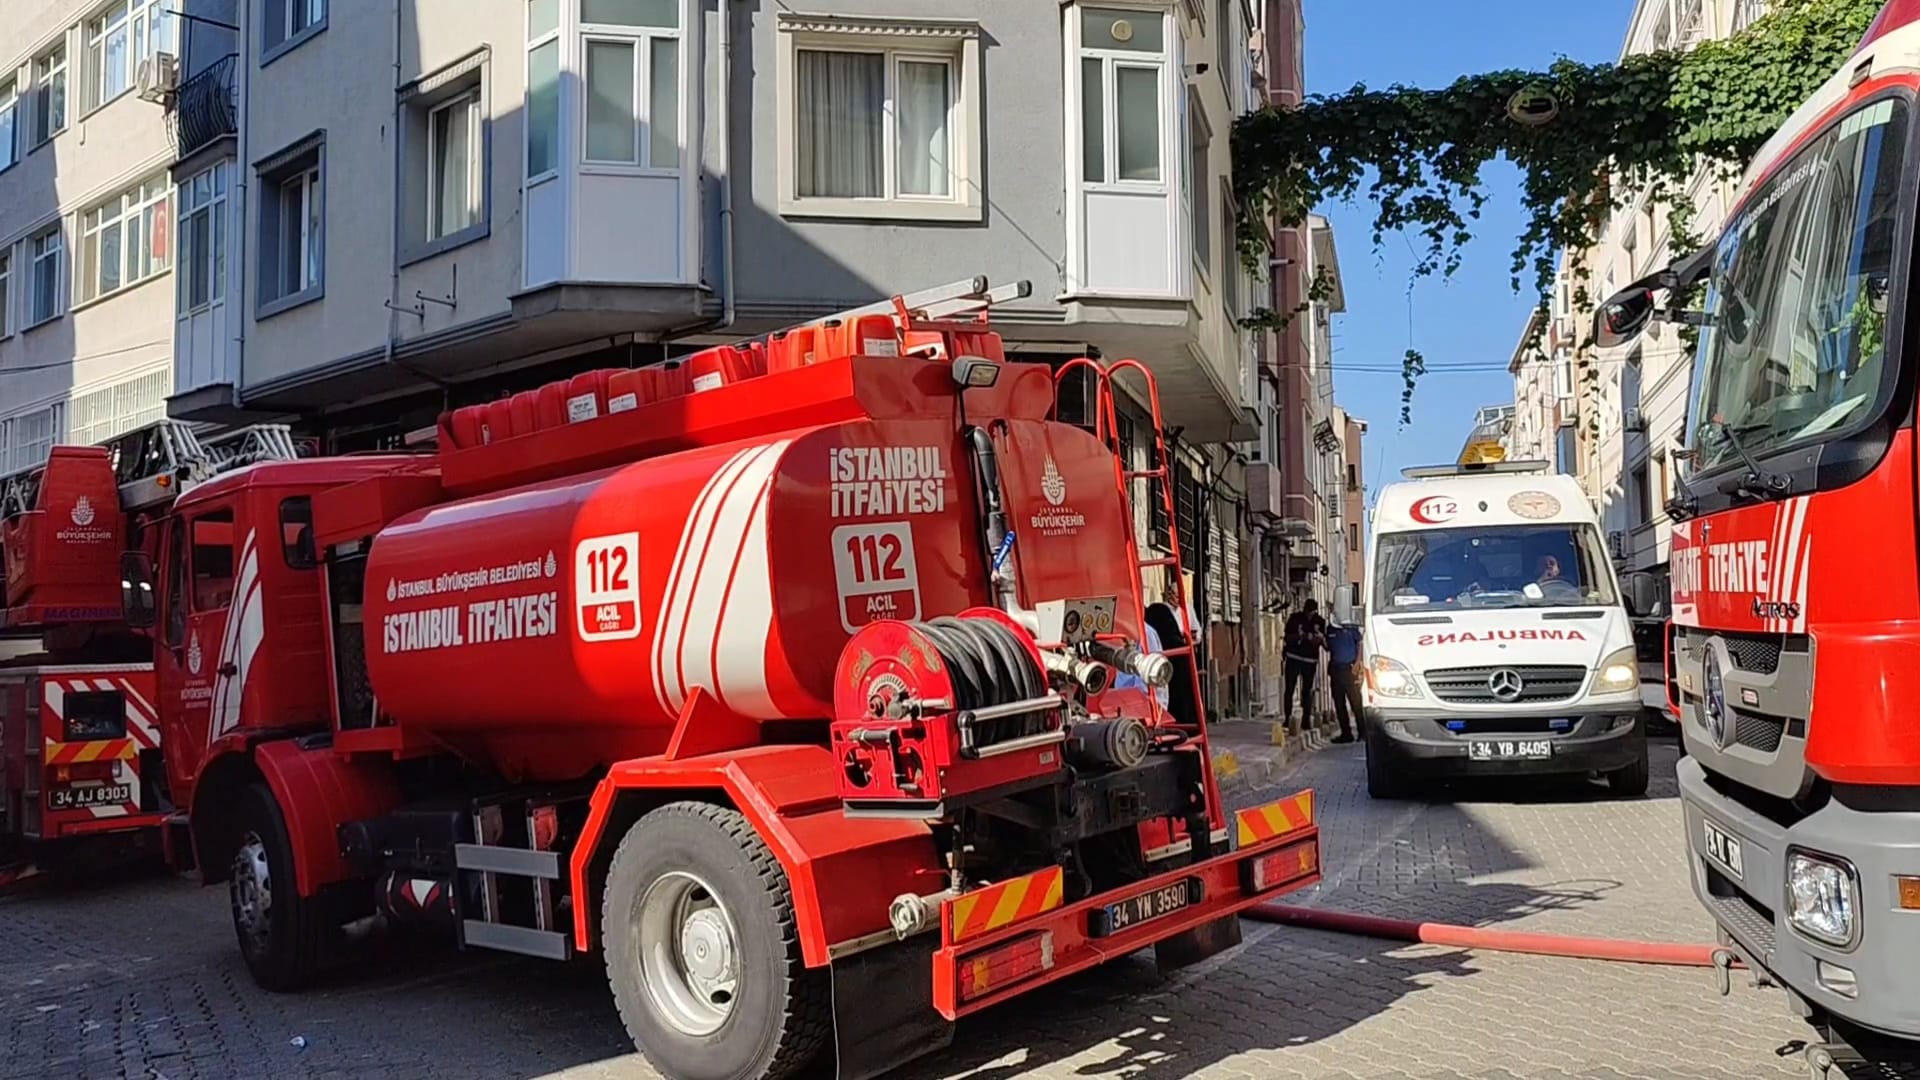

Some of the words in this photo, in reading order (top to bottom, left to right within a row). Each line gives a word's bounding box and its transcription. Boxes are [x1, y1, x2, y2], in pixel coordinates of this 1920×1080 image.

[830, 446, 947, 482] İSTANBUL
[831, 479, 944, 518] İTFAİYESİ
[1422, 502, 1458, 515] 112
[397, 578, 435, 599] İSTANBUL
[436, 567, 489, 592] BÜYÜKŞEHİR
[490, 557, 542, 585] BELEDİYESİ
[587, 546, 629, 593] 112
[847, 533, 907, 583] 112
[1708, 540, 1768, 593] İTFAİYE
[384, 606, 463, 653] İSTANBUL
[468, 592, 558, 644] İTFAİYESİ
[1476, 742, 1492, 757] 34
[1497, 742, 1513, 756] YB
[1519, 741, 1548, 755] 6405
[56, 790, 73, 805] 34
[77, 788, 93, 802] AJ
[97, 785, 128, 801] 8303
[1113, 902, 1129, 929] 34
[1136, 894, 1152, 920] YN
[1157, 883, 1186, 913] 3590
